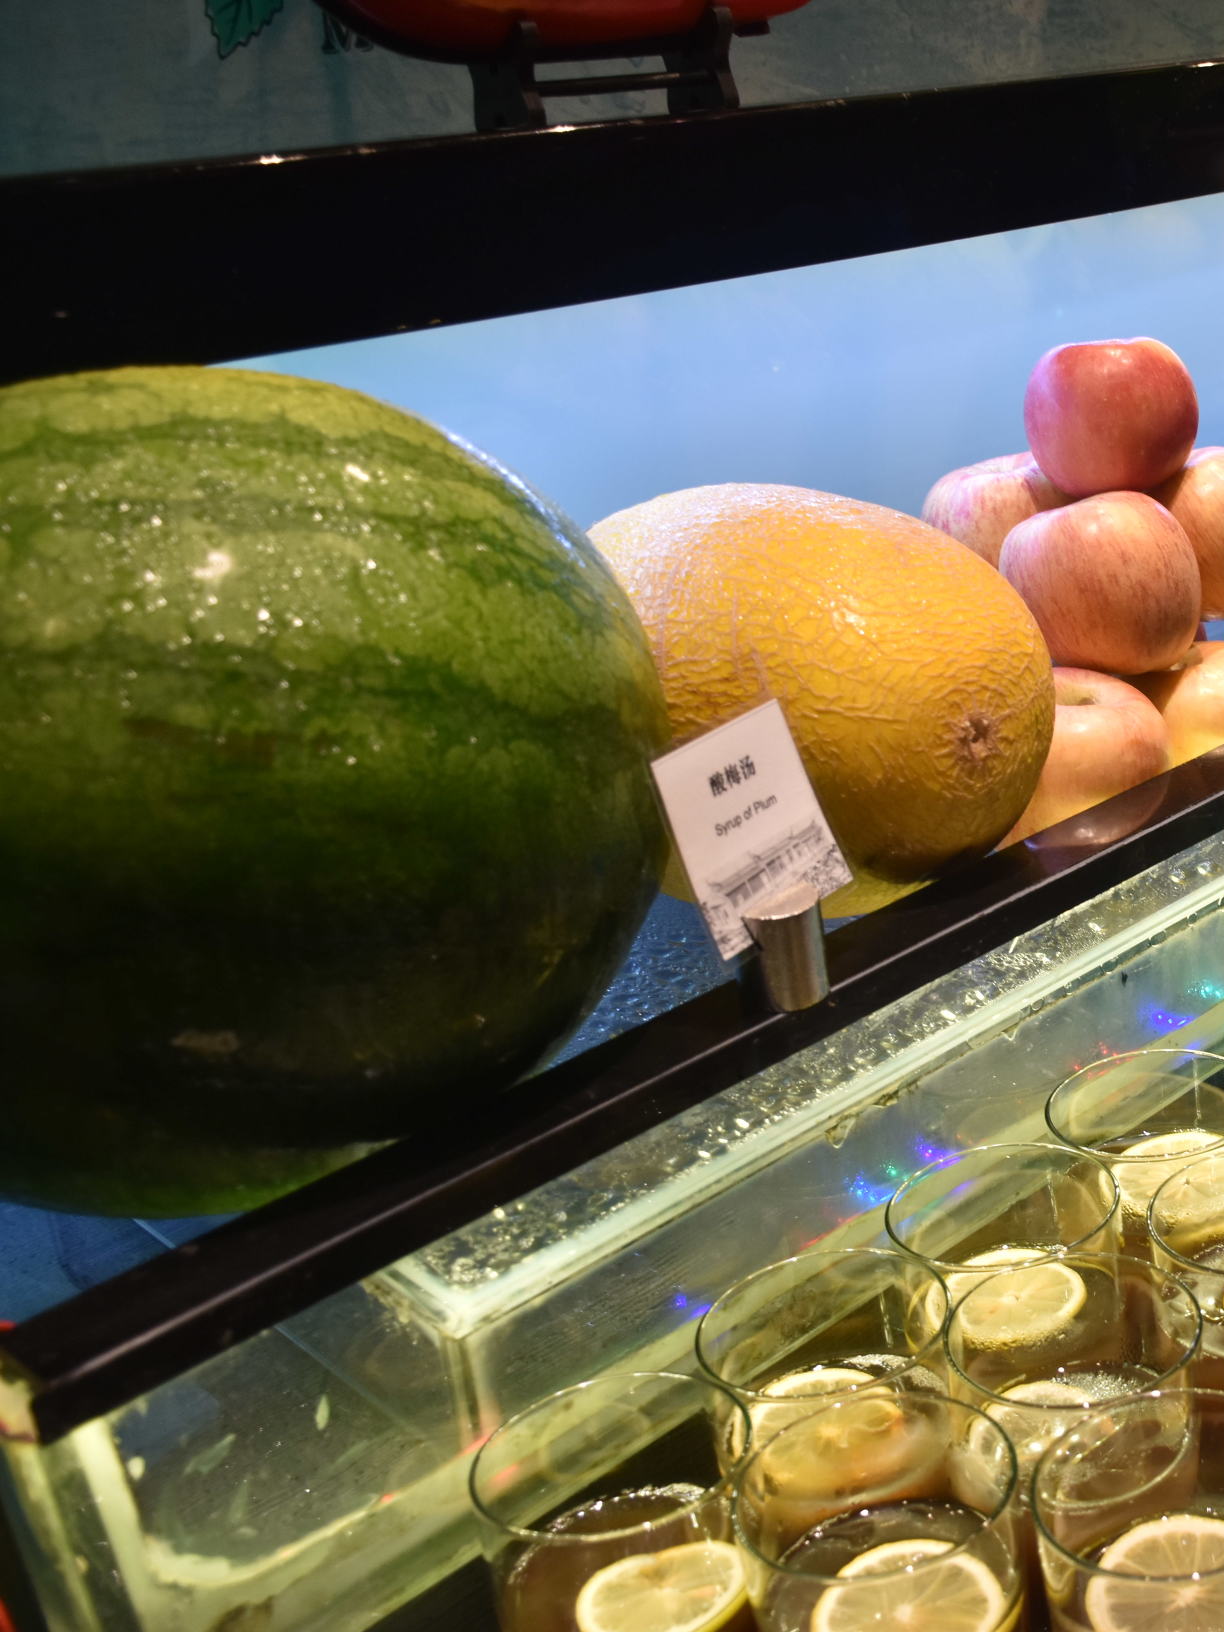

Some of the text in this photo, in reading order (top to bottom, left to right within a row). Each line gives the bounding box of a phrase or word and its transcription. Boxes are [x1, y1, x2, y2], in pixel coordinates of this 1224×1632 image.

[709, 755, 757, 797] 酸梅汤
[714, 795, 778, 837] Syrup of Plum
